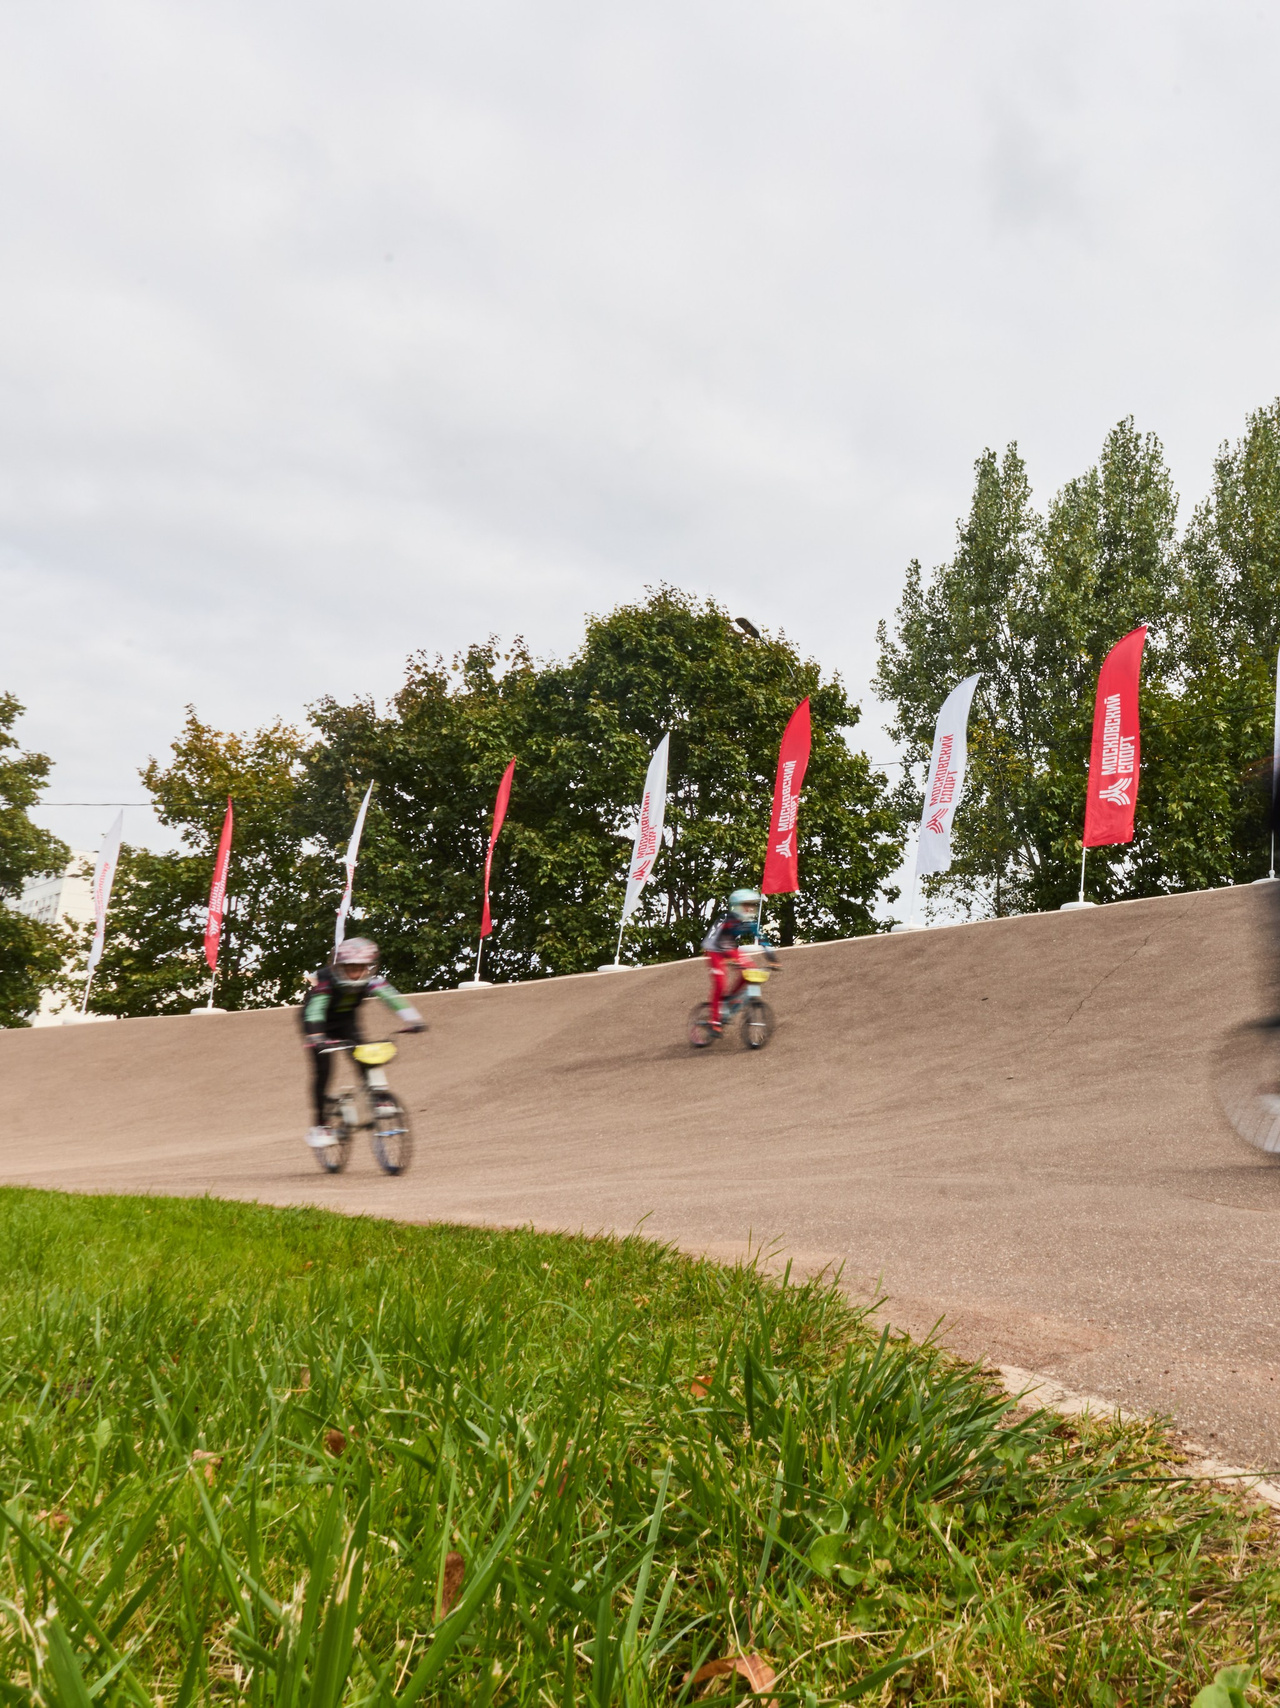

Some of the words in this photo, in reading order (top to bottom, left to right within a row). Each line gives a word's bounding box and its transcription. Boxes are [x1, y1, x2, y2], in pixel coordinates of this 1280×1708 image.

[929, 733, 955, 808] МОСКОВСКИЙ
[1101, 693, 1121, 776] МОСКОВСКИЙ
[1117, 735, 1136, 774] СПОРТ
[777, 760, 798, 832] МОСКОВСКИЙ
[939, 770, 958, 804] СПОРТ
